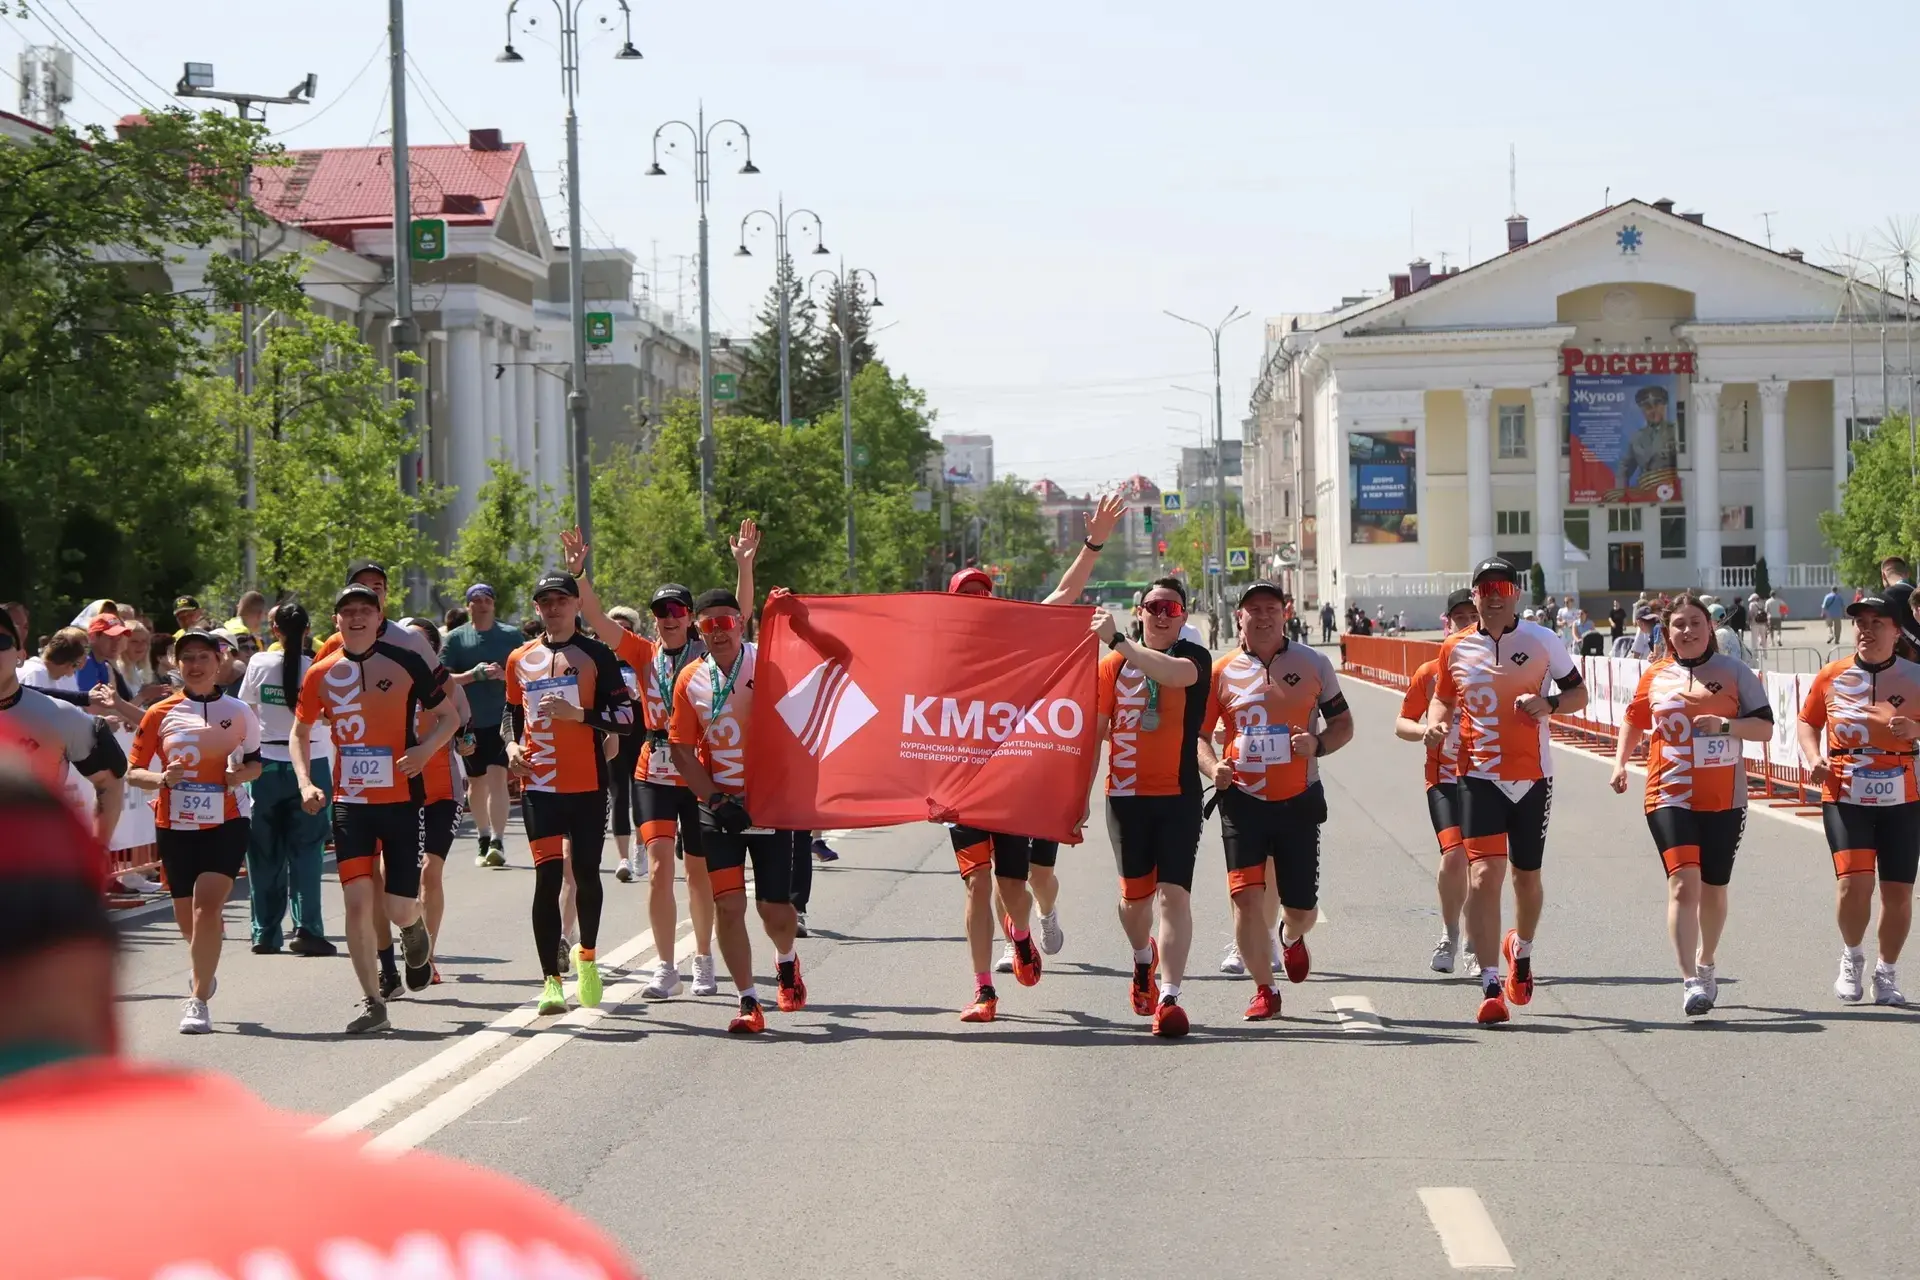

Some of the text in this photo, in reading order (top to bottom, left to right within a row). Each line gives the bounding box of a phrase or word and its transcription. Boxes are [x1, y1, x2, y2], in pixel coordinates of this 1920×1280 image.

[1573, 389, 1625, 404] Жуков
[902, 694, 1083, 743] КМЗКО
[900, 741, 955, 753] КУРГАНСКИЙ
[1056, 744, 1082, 756] ЗАВОД
[1248, 738, 1275, 752] 611
[1707, 740, 1731, 755] 591
[899, 751, 968, 763] КОНВЕЙЕРНОГО
[352, 760, 379, 774] 602
[1864, 782, 1894, 795] 600
[183, 796, 211, 810] 594
